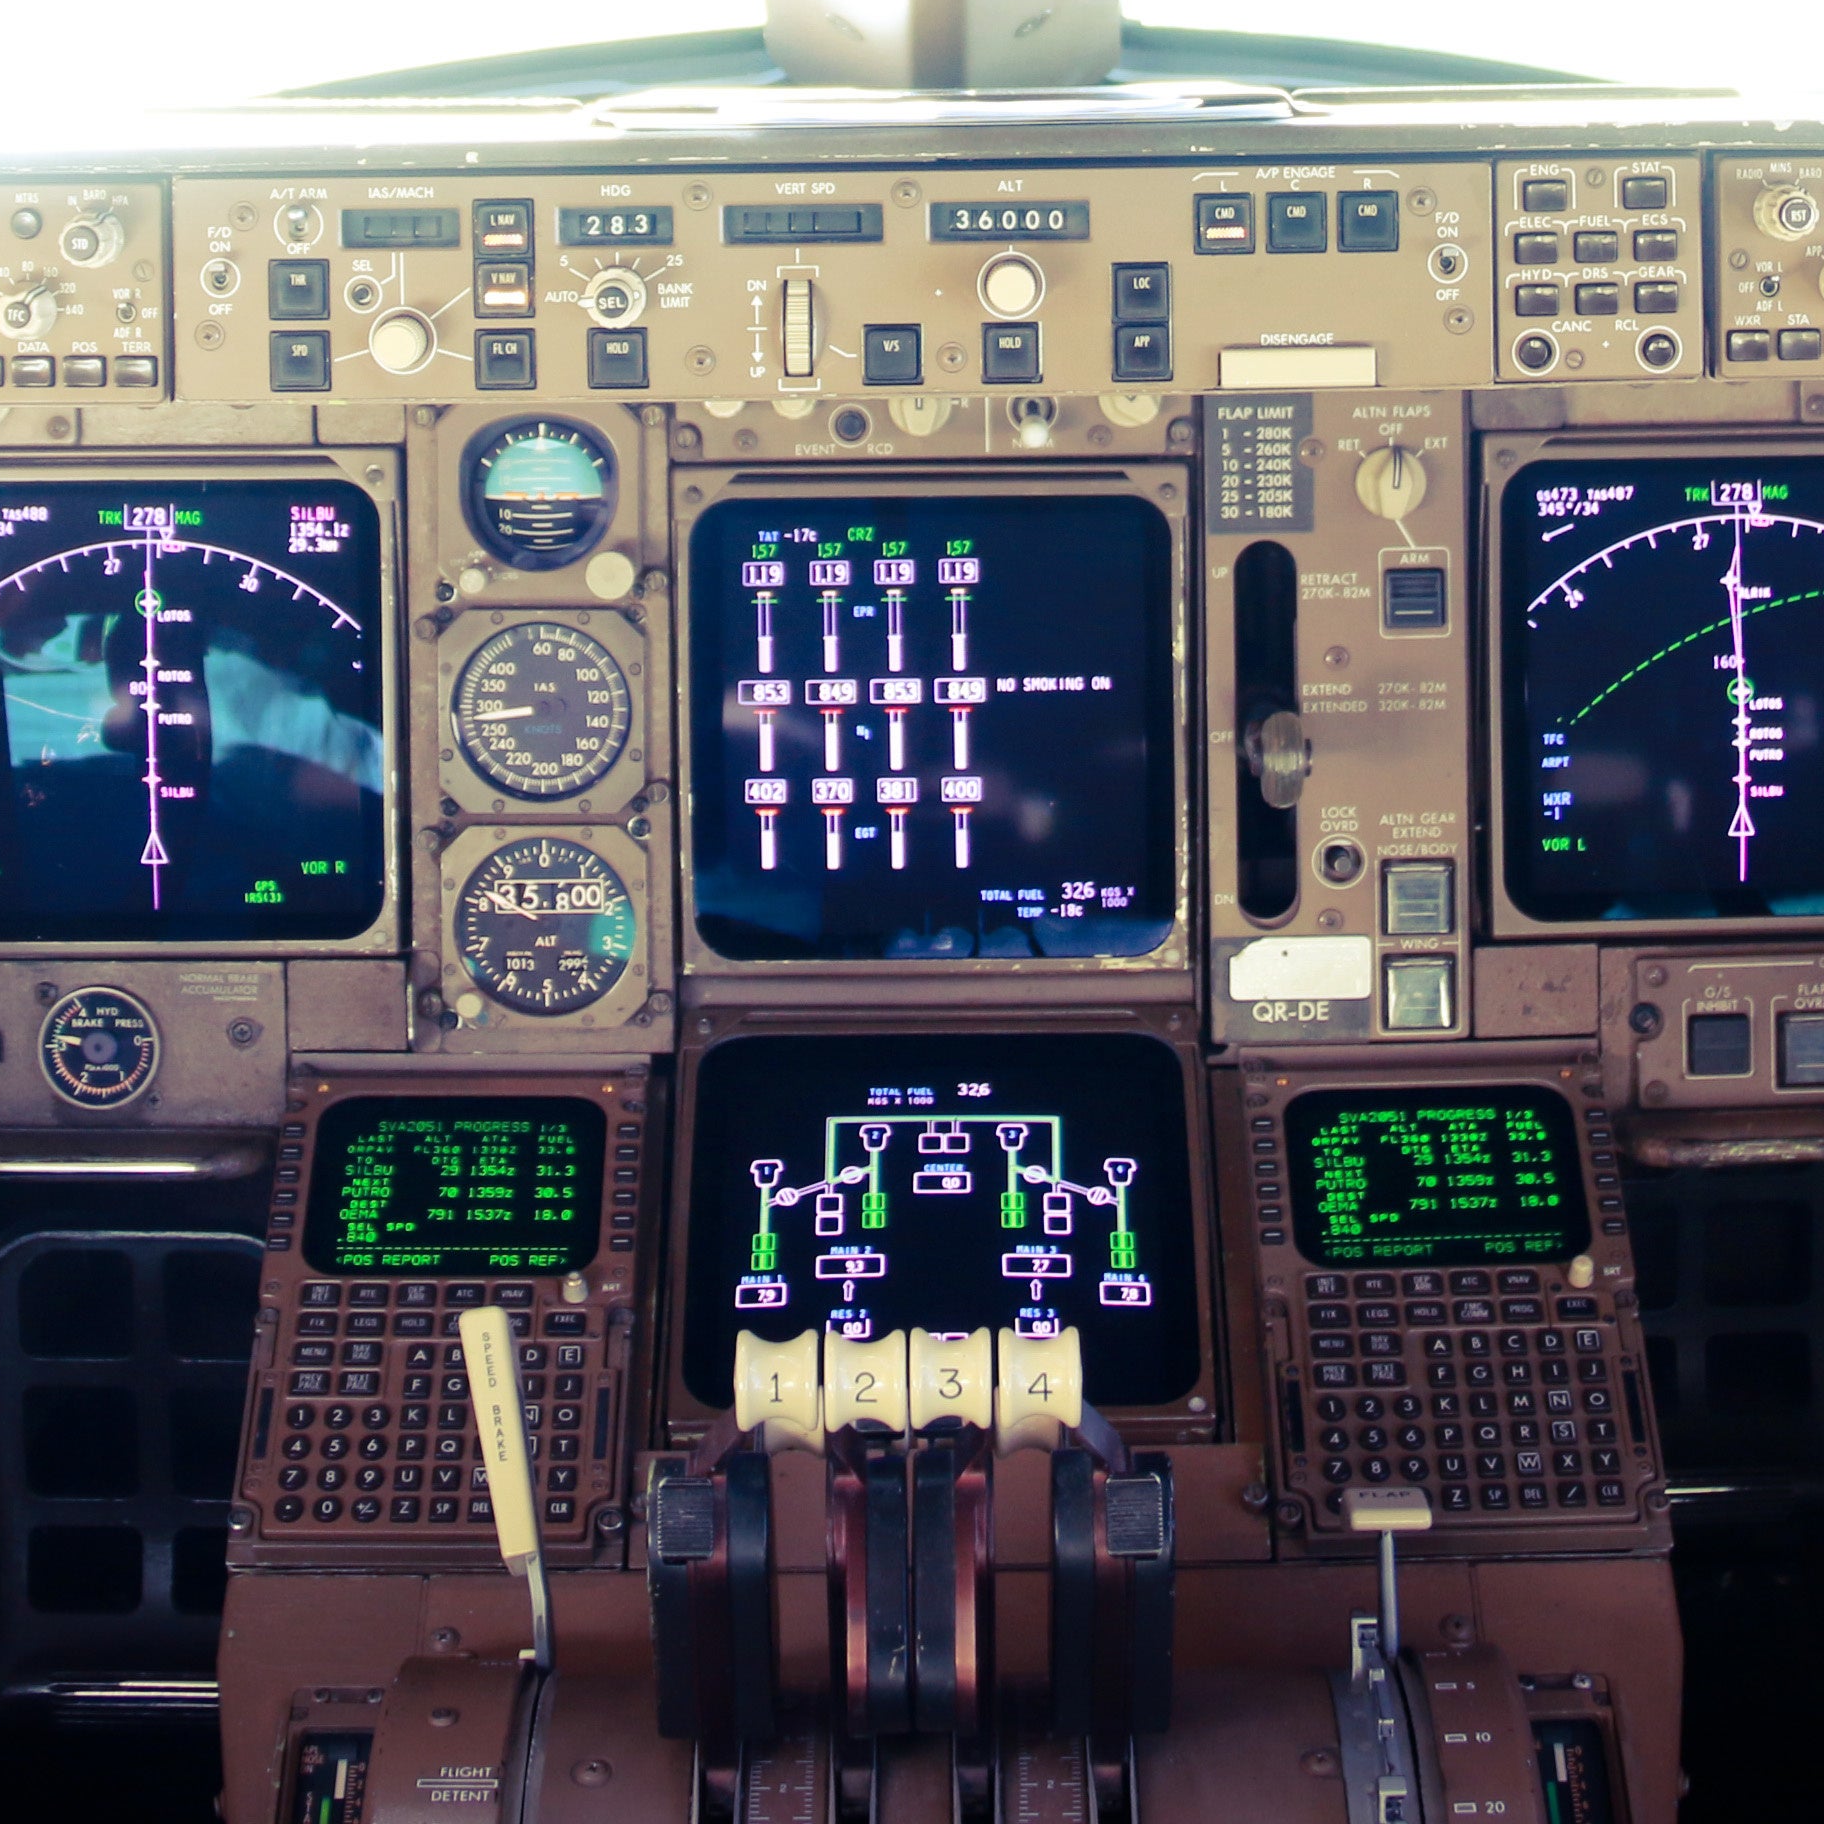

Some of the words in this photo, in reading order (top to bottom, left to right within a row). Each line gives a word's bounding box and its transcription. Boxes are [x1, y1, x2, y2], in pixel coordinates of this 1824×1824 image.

[1256, 167, 1280, 179] A/P
[1283, 166, 1336, 179] ENGAGE
[1530, 164, 1559, 176] ENG
[1632, 161, 1661, 174] STAT
[775, 183, 806, 194] VERT
[811, 183, 835, 194] SPD
[998, 180, 1023, 192] ALT
[1290, 179, 1300, 191] C
[1363, 178, 1372, 189] R
[270, 188, 295, 199] A/T
[299, 188, 327, 199] ARM
[368, 187, 433, 198] IAS/MACH
[601, 185, 631, 196] HDG
[1215, 207, 1234, 219] CMD
[1287, 206, 1306, 217] CMD
[1359, 205, 1377, 216] CMD
[498, 214, 515, 225] NAV
[955, 209, 1064, 231] 36000
[1436, 212, 1459, 223] F/D
[1520, 216, 1551, 229] ELEC
[1580, 215, 1610, 227] FUEL
[1643, 214, 1668, 226] ECS
[208, 227, 231, 238] F/D
[1437, 227, 1458, 238] ON
[210, 241, 231, 252] ON
[287, 243, 310, 254] OFF
[352, 260, 373, 271] SEL
[1522, 269, 1552, 280] HYD
[1583, 267, 1608, 279] DRS
[1638, 266, 1675, 278] GEAR
[290, 274, 306, 285] THR
[499, 273, 515, 284] NAV
[1134, 277, 1149, 289] LOC
[658, 283, 693, 294] BANK
[747, 280, 766, 291] DN
[544, 291, 578, 302] AUTO
[1436, 289, 1459, 300] OFF
[599, 297, 626, 309] SEL
[661, 297, 690, 308] LIMIT
[209, 304, 232, 315] OFF
[1615, 319, 1639, 331] RCL
[1735, 315, 1761, 327] WXR
[1787, 314, 1810, 325] STA
[1552, 320, 1591, 332] CANC
[883, 340, 899, 351] V/S
[999, 337, 1021, 348] HOLD
[1135, 336, 1150, 347] APP
[1260, 333, 1334, 346] DISENGAGE
[292, 345, 308, 356] SPD
[493, 343, 503, 354] FL
[505, 343, 517, 354] CH
[607, 342, 629, 353] HOLD
[750, 367, 765, 377] UP
[1218, 407, 1253, 420] FLAP
[1258, 406, 1293, 419] LIMIT
[1353, 406, 1386, 418] ALTN
[1393, 405, 1430, 417] FLAPS
[1379, 423, 1402, 435] OFF
[1338, 439, 1359, 451] RET
[1425, 437, 1447, 449] EXT
[1223, 459, 1239, 471] 10
[1222, 475, 1240, 487] 20
[1222, 490, 1239, 503] 25
[99, 511, 122, 524] TRK
[132, 507, 167, 526] 278
[175, 511, 200, 525] MAG
[1221, 506, 1239, 518] 30
[848, 527, 873, 541] CRZ
[1399, 553, 1431, 565] ARM
[1301, 573, 1357, 586] RETRACT
[533, 643, 551, 655] 60
[558, 648, 575, 661] 80
[576, 669, 598, 681] 100
[997, 678, 1017, 692] NO
[1023, 677, 1085, 691] SMOKING
[1092, 676, 1112, 690] ON
[1303, 683, 1352, 696] EXTEND
[1303, 701, 1367, 713] EXTENDED
[532, 762, 559, 775] 200
[749, 783, 783, 800] 402
[815, 783, 849, 800] 370
[879, 782, 913, 800] 381
[944, 781, 978, 799] 400
[1322, 807, 1356, 818] LOCK
[1379, 814, 1413, 825] ALTN
[1420, 813, 1455, 824] GEAR
[1320, 820, 1358, 832] OVRD
[1393, 826, 1442, 839] EXTEND
[1377, 844, 1458, 857] NOSE/BODY
[535, 936, 556, 947] ALT
[1400, 938, 1439, 951] WING
[1253, 1001, 1328, 1023] QR-DE
[454, 1121, 530, 1132] PROGRESS
[341, 1187, 392, 1197] PUTRO
[428, 1209, 453, 1220] 791
[770, 1373, 782, 1403] 1
[855, 1372, 877, 1403] 2
[939, 1369, 962, 1399] 3
[1028, 1373, 1052, 1402] 4
